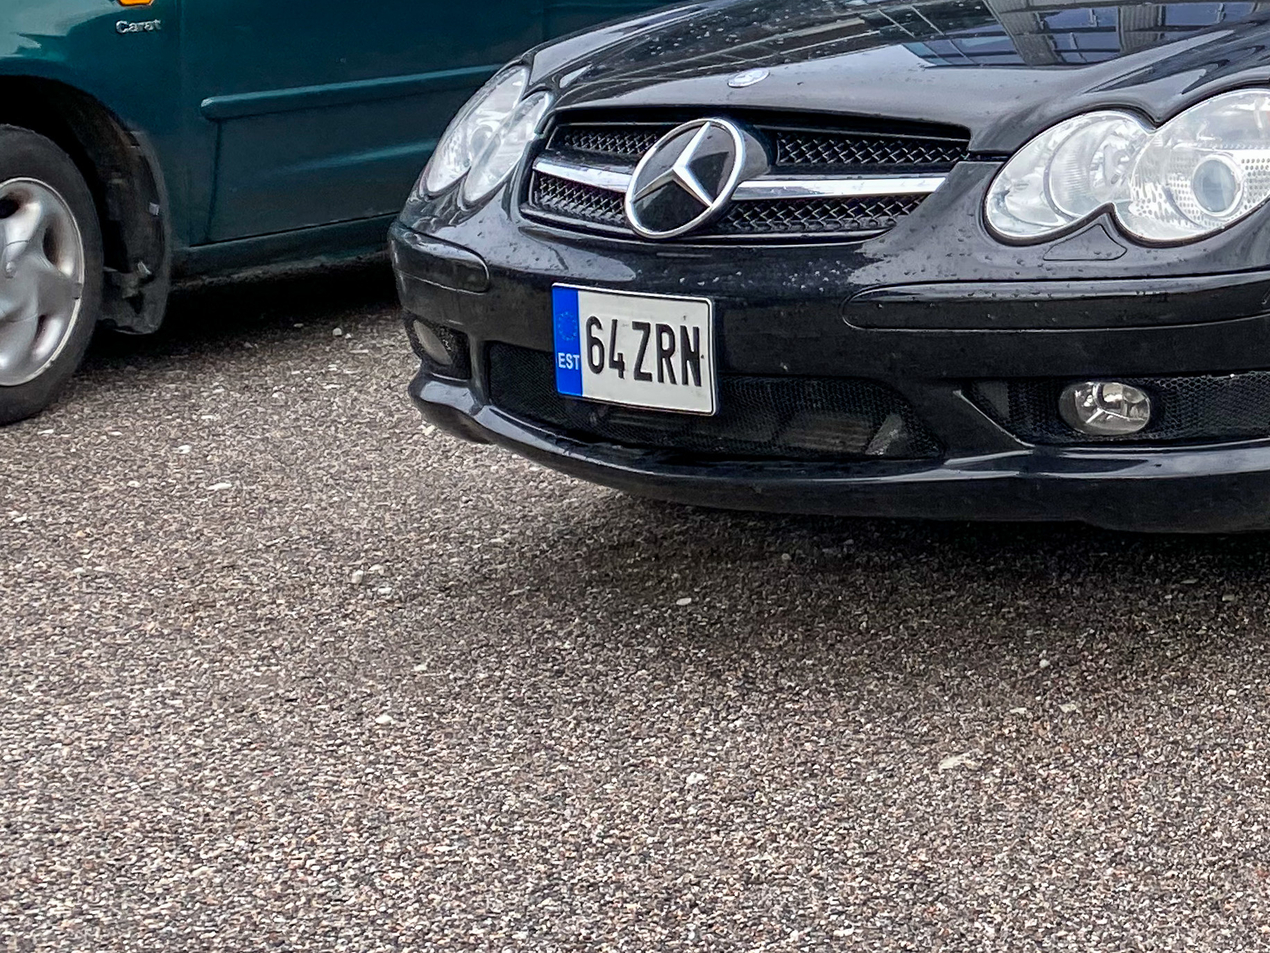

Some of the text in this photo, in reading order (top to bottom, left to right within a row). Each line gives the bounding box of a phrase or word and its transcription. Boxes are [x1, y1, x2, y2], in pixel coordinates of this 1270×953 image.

[115, 18, 161, 34] Carat
[585, 315, 702, 387] 64ZRN
[557, 352, 580, 371] EST
